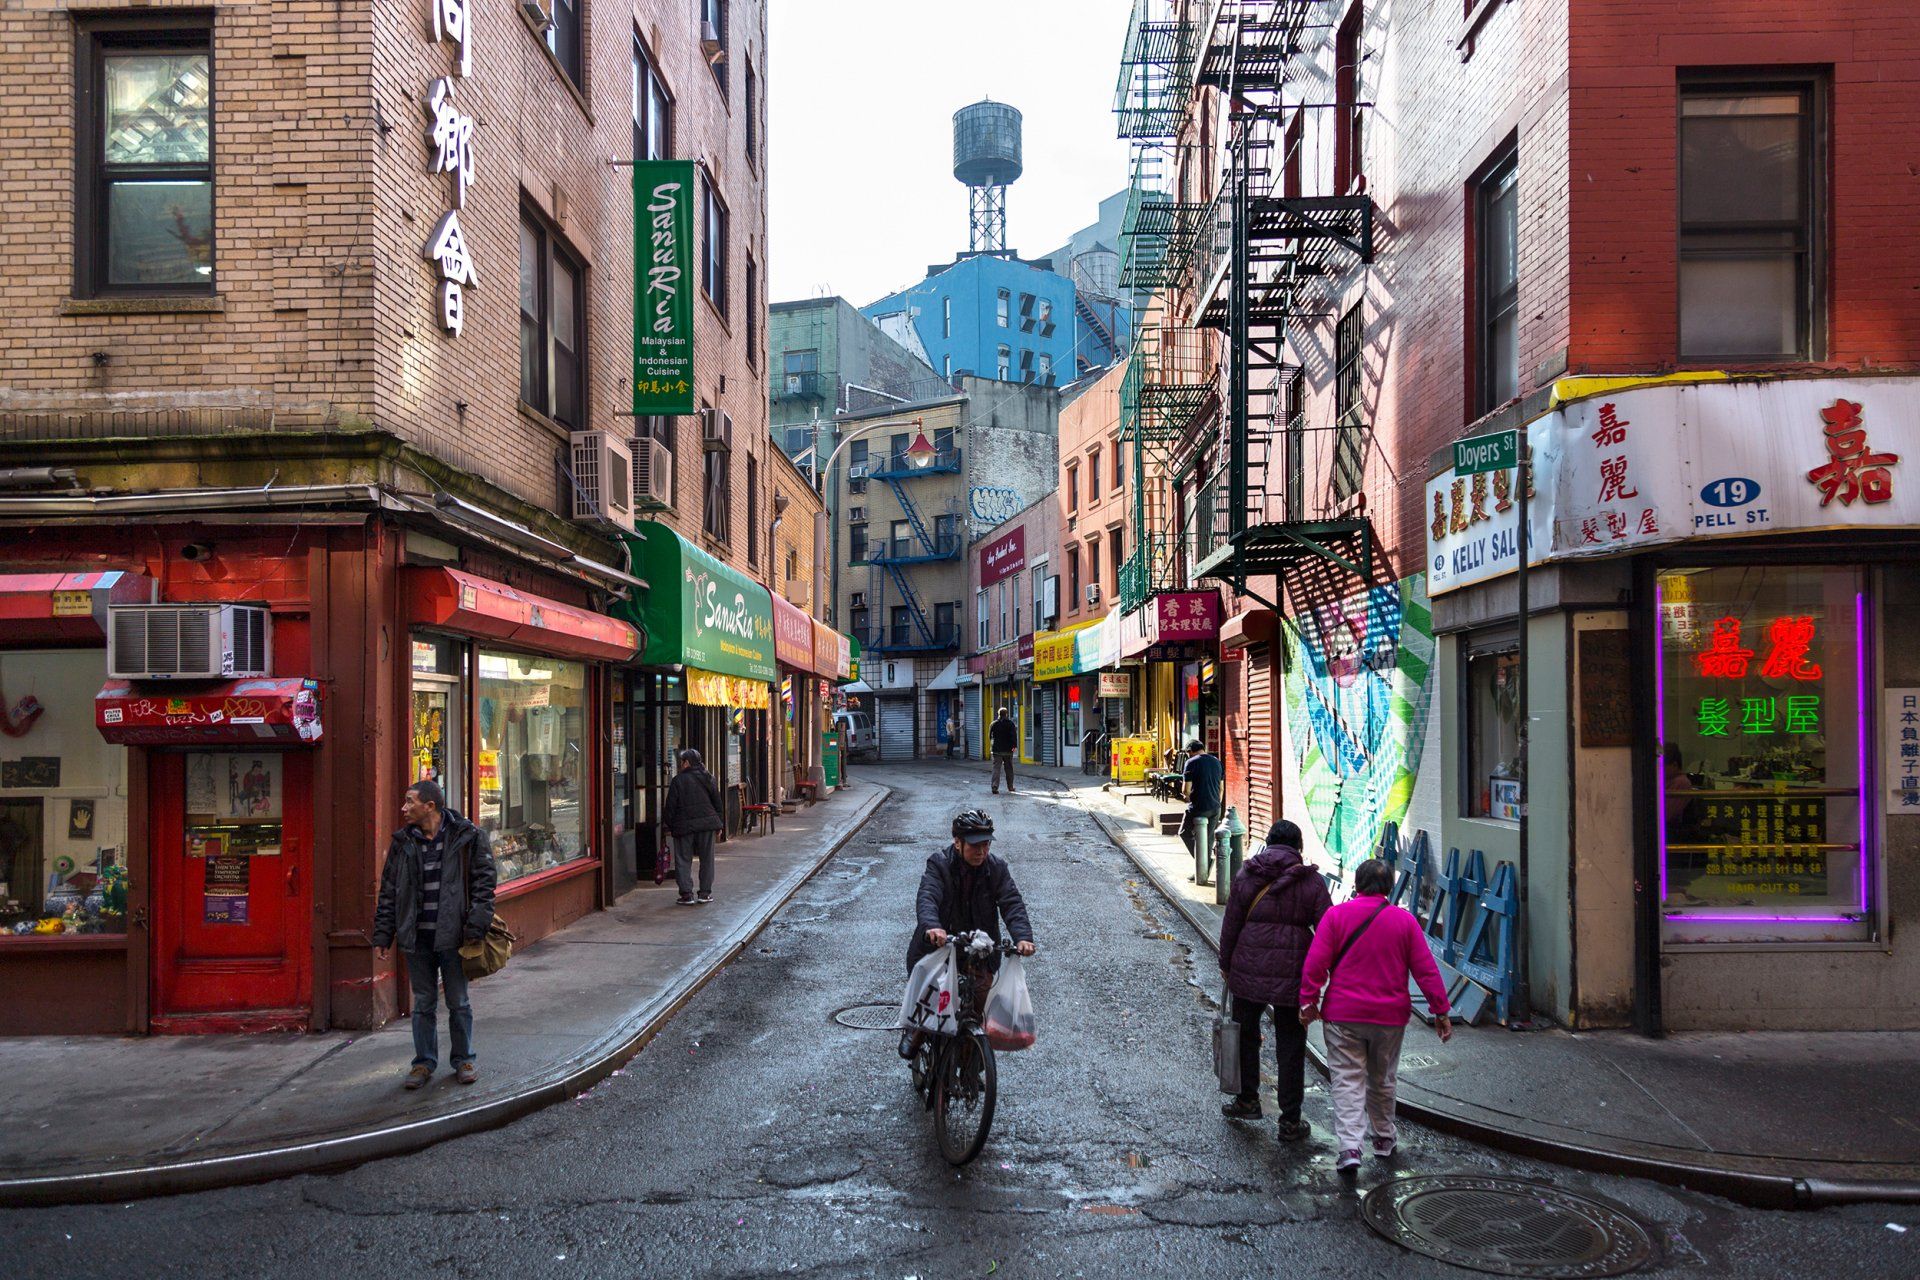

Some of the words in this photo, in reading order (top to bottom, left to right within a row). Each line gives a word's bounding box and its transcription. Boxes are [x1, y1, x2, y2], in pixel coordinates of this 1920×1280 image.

[642, 337, 686, 347] Malaysian
[659, 348, 668, 356] &
[639, 357, 688, 365] Indonesian
[647, 367, 681, 375] Cuisine
[1458, 442, 1500, 470] Doyers
[1504, 435, 1513, 450] St
[1592, 402, 1639, 505] 嘉麗
[1806, 398, 1900, 507] 嘉
[1714, 481, 1747, 504] 19
[1580, 509, 1660, 545] 髮型屋
[1695, 513, 1736, 527] PELL
[1747, 509, 1769, 522] ST.
[1452, 538, 1486, 575] KELLY
[1492, 519, 1533, 561] SALN
[1164, 598, 1207, 617] 香港
[1698, 616, 1823, 680] 嘉麗
[1696, 695, 1820, 736] 髮型屋
[1728, 884, 1755, 893] HAIR
[1760, 883, 1784, 893] CUT
[919, 984, 939, 1006] I
